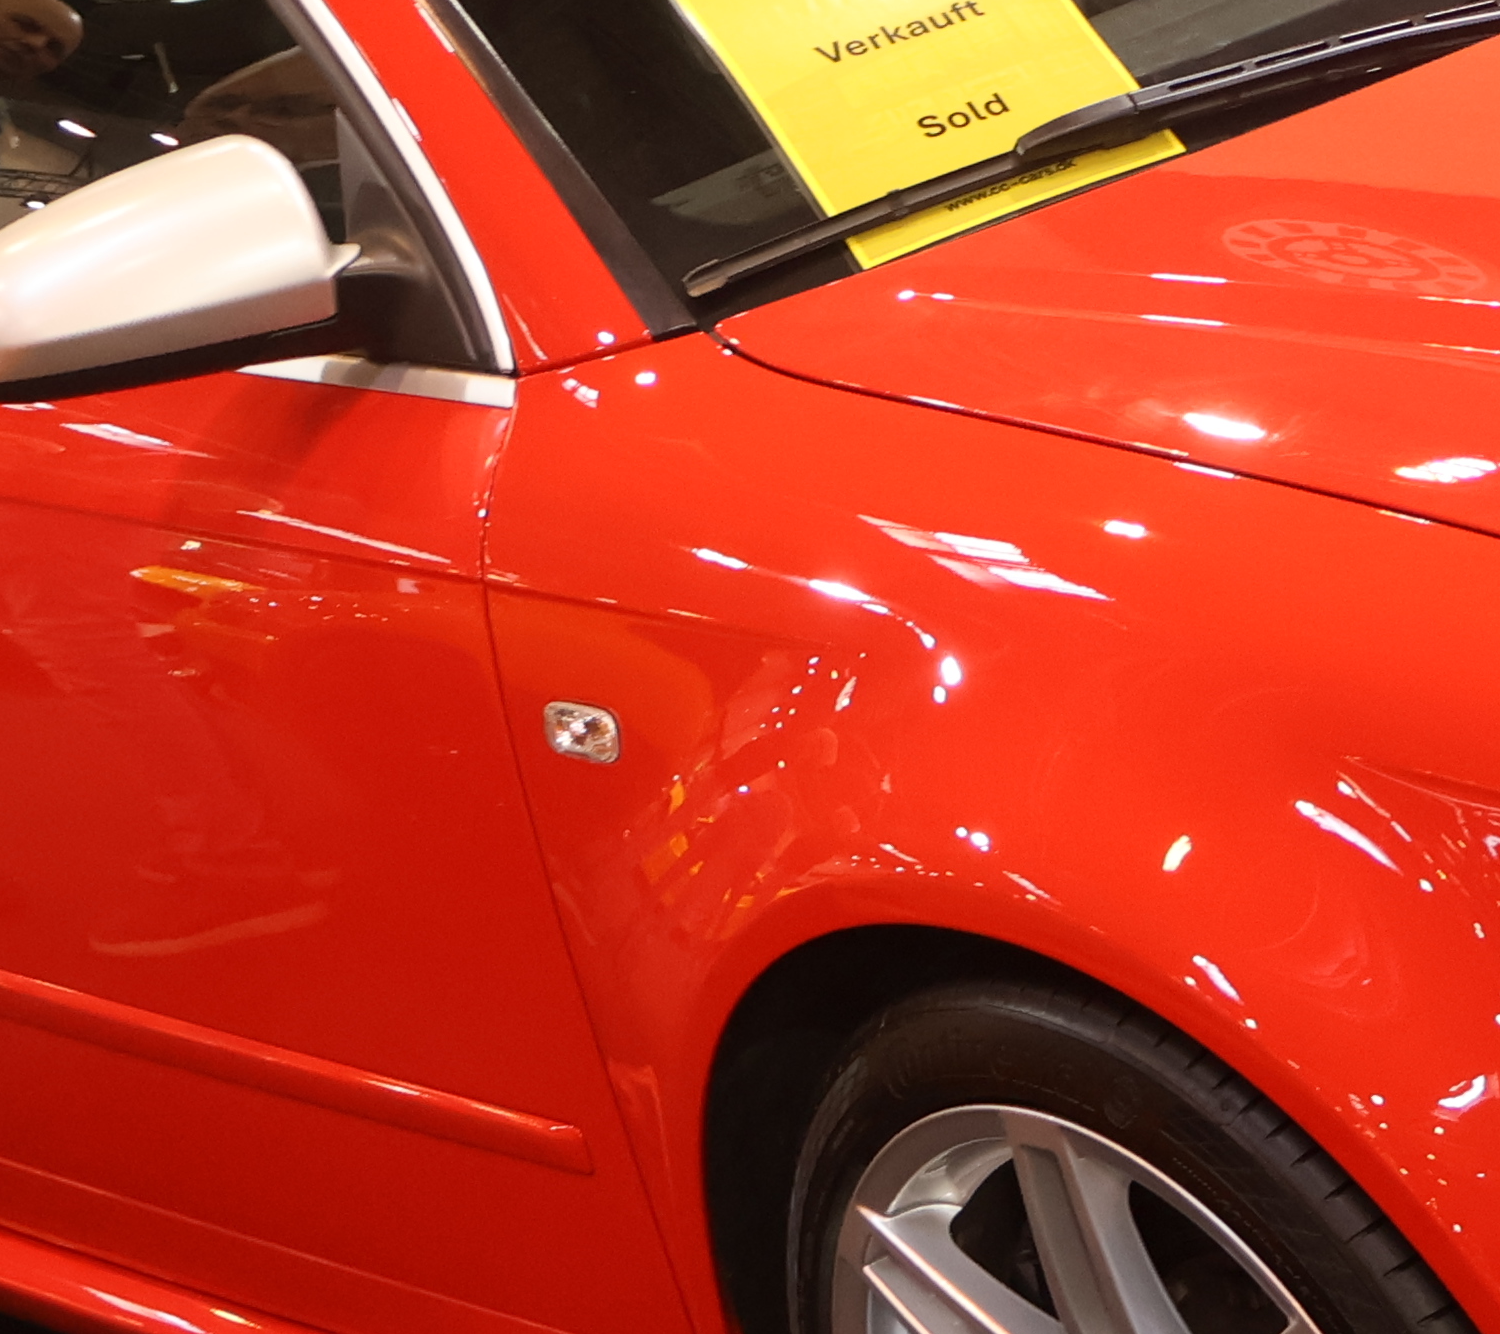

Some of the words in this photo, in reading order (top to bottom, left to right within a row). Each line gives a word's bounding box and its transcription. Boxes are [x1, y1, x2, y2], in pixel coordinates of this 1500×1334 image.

[813, 0, 986, 64] Verkauft
[916, 92, 1011, 138] Sold
[945, 157, 1078, 212] www.cc-cars.dk
